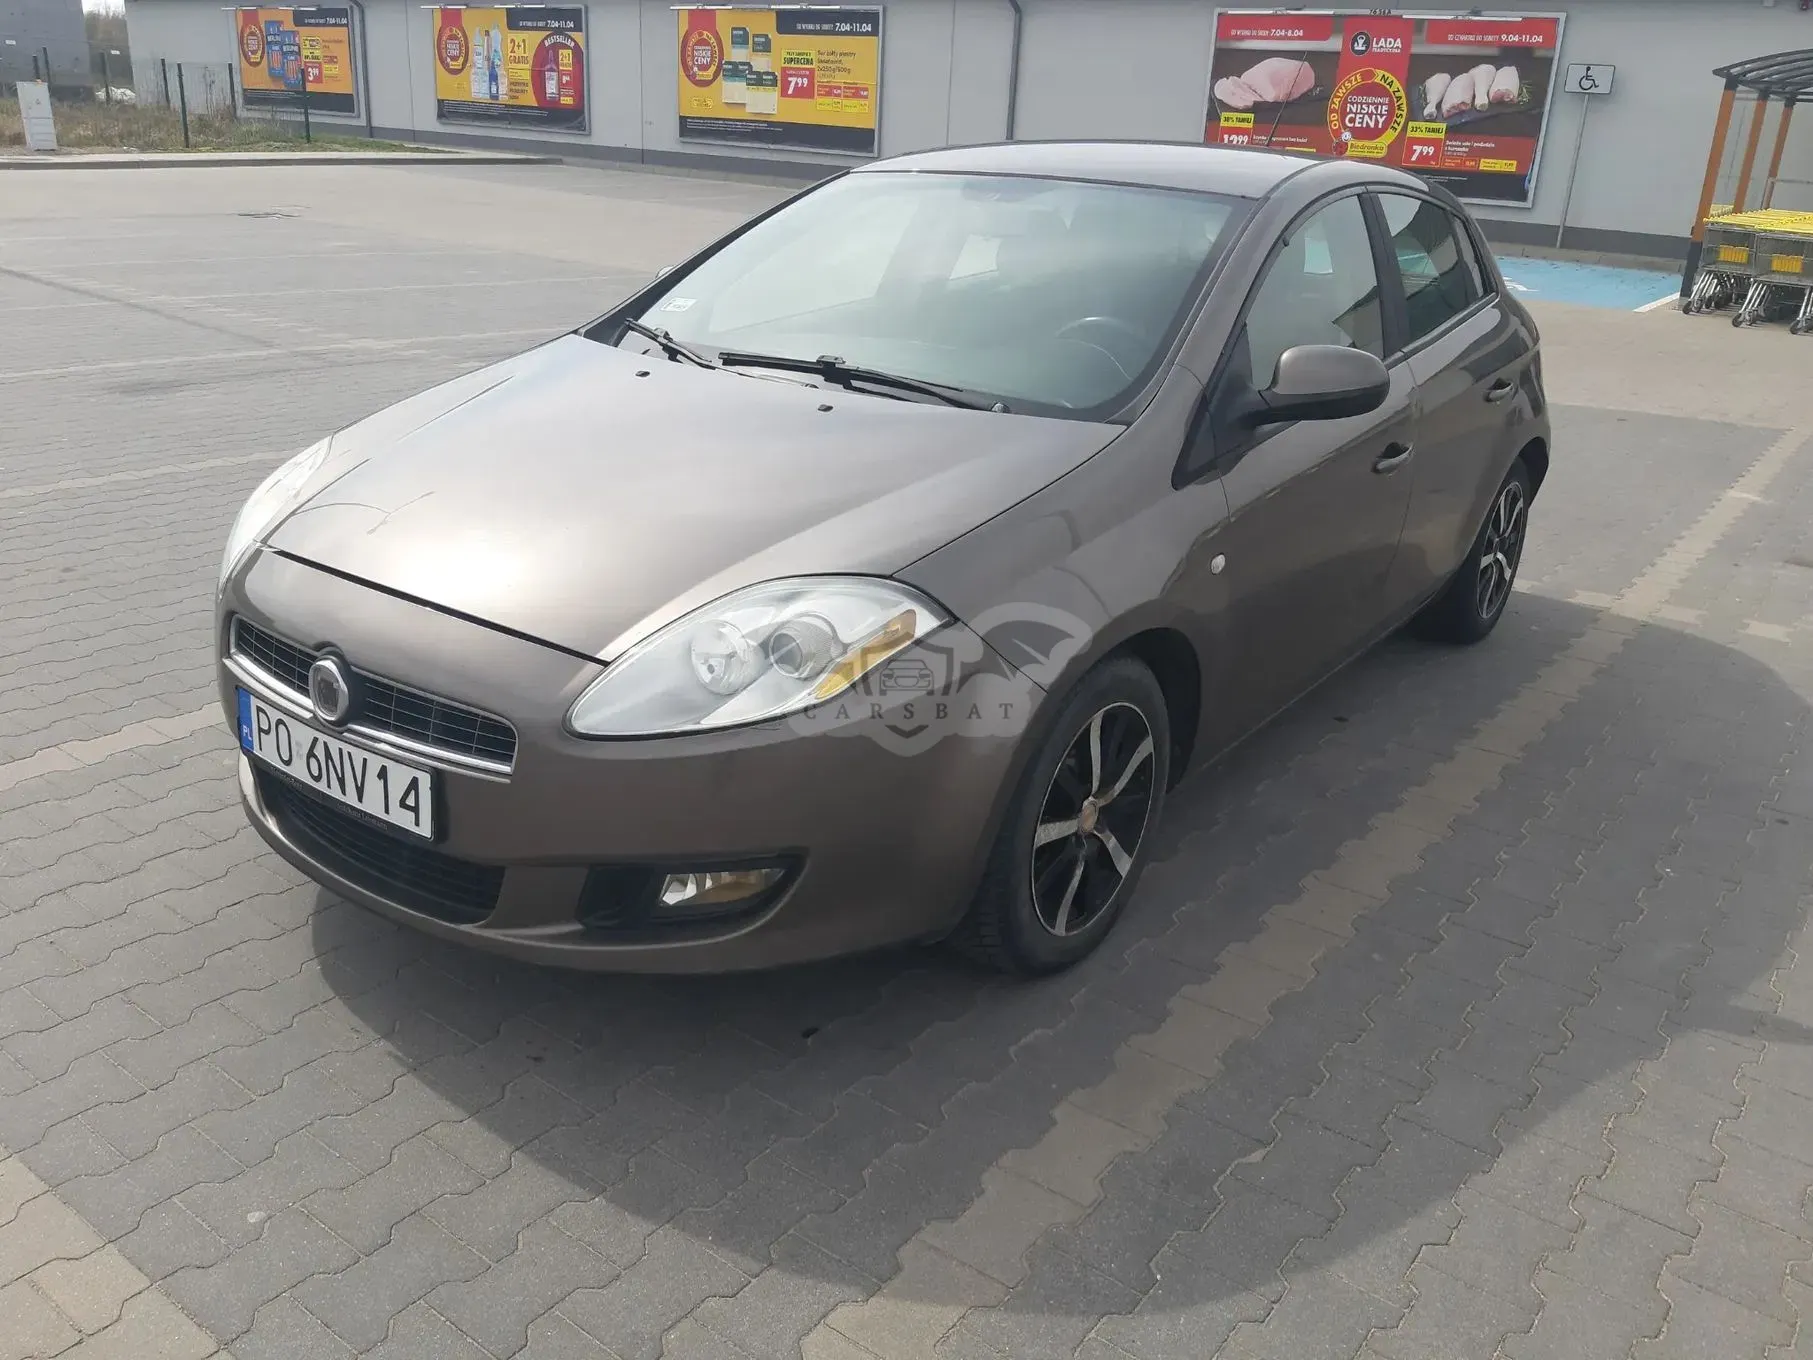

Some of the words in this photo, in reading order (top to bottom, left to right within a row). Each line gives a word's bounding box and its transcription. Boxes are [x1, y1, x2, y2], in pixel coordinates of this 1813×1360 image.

[835, 23, 872, 31] 7.04-11.04
[544, 35, 575, 48] BESTSELLER
[1372, 38, 1402, 48] LADA
[1501, 34, 1543, 42] 9.04-11.04
[510, 38, 526, 54] 2+1
[509, 56, 529, 65] GRATIS
[784, 57, 813, 65] SUPERCENA
[788, 77, 808, 94] 799
[1331, 73, 1362, 110] ZAWSZE
[1346, 104, 1389, 114] NISKIE
[1380, 74, 1395, 89] NA
[1390, 87, 1405, 132] ZAWSZE
[1330, 113, 1339, 129] OD
[1345, 114, 1387, 128] CENY
[1350, 142, 1384, 151] Biedronka
[1411, 146, 1434, 161] 799
[242, 725, 252, 740] PL
[256, 704, 293, 766] PO
[306, 736, 420, 827] 6NV14
